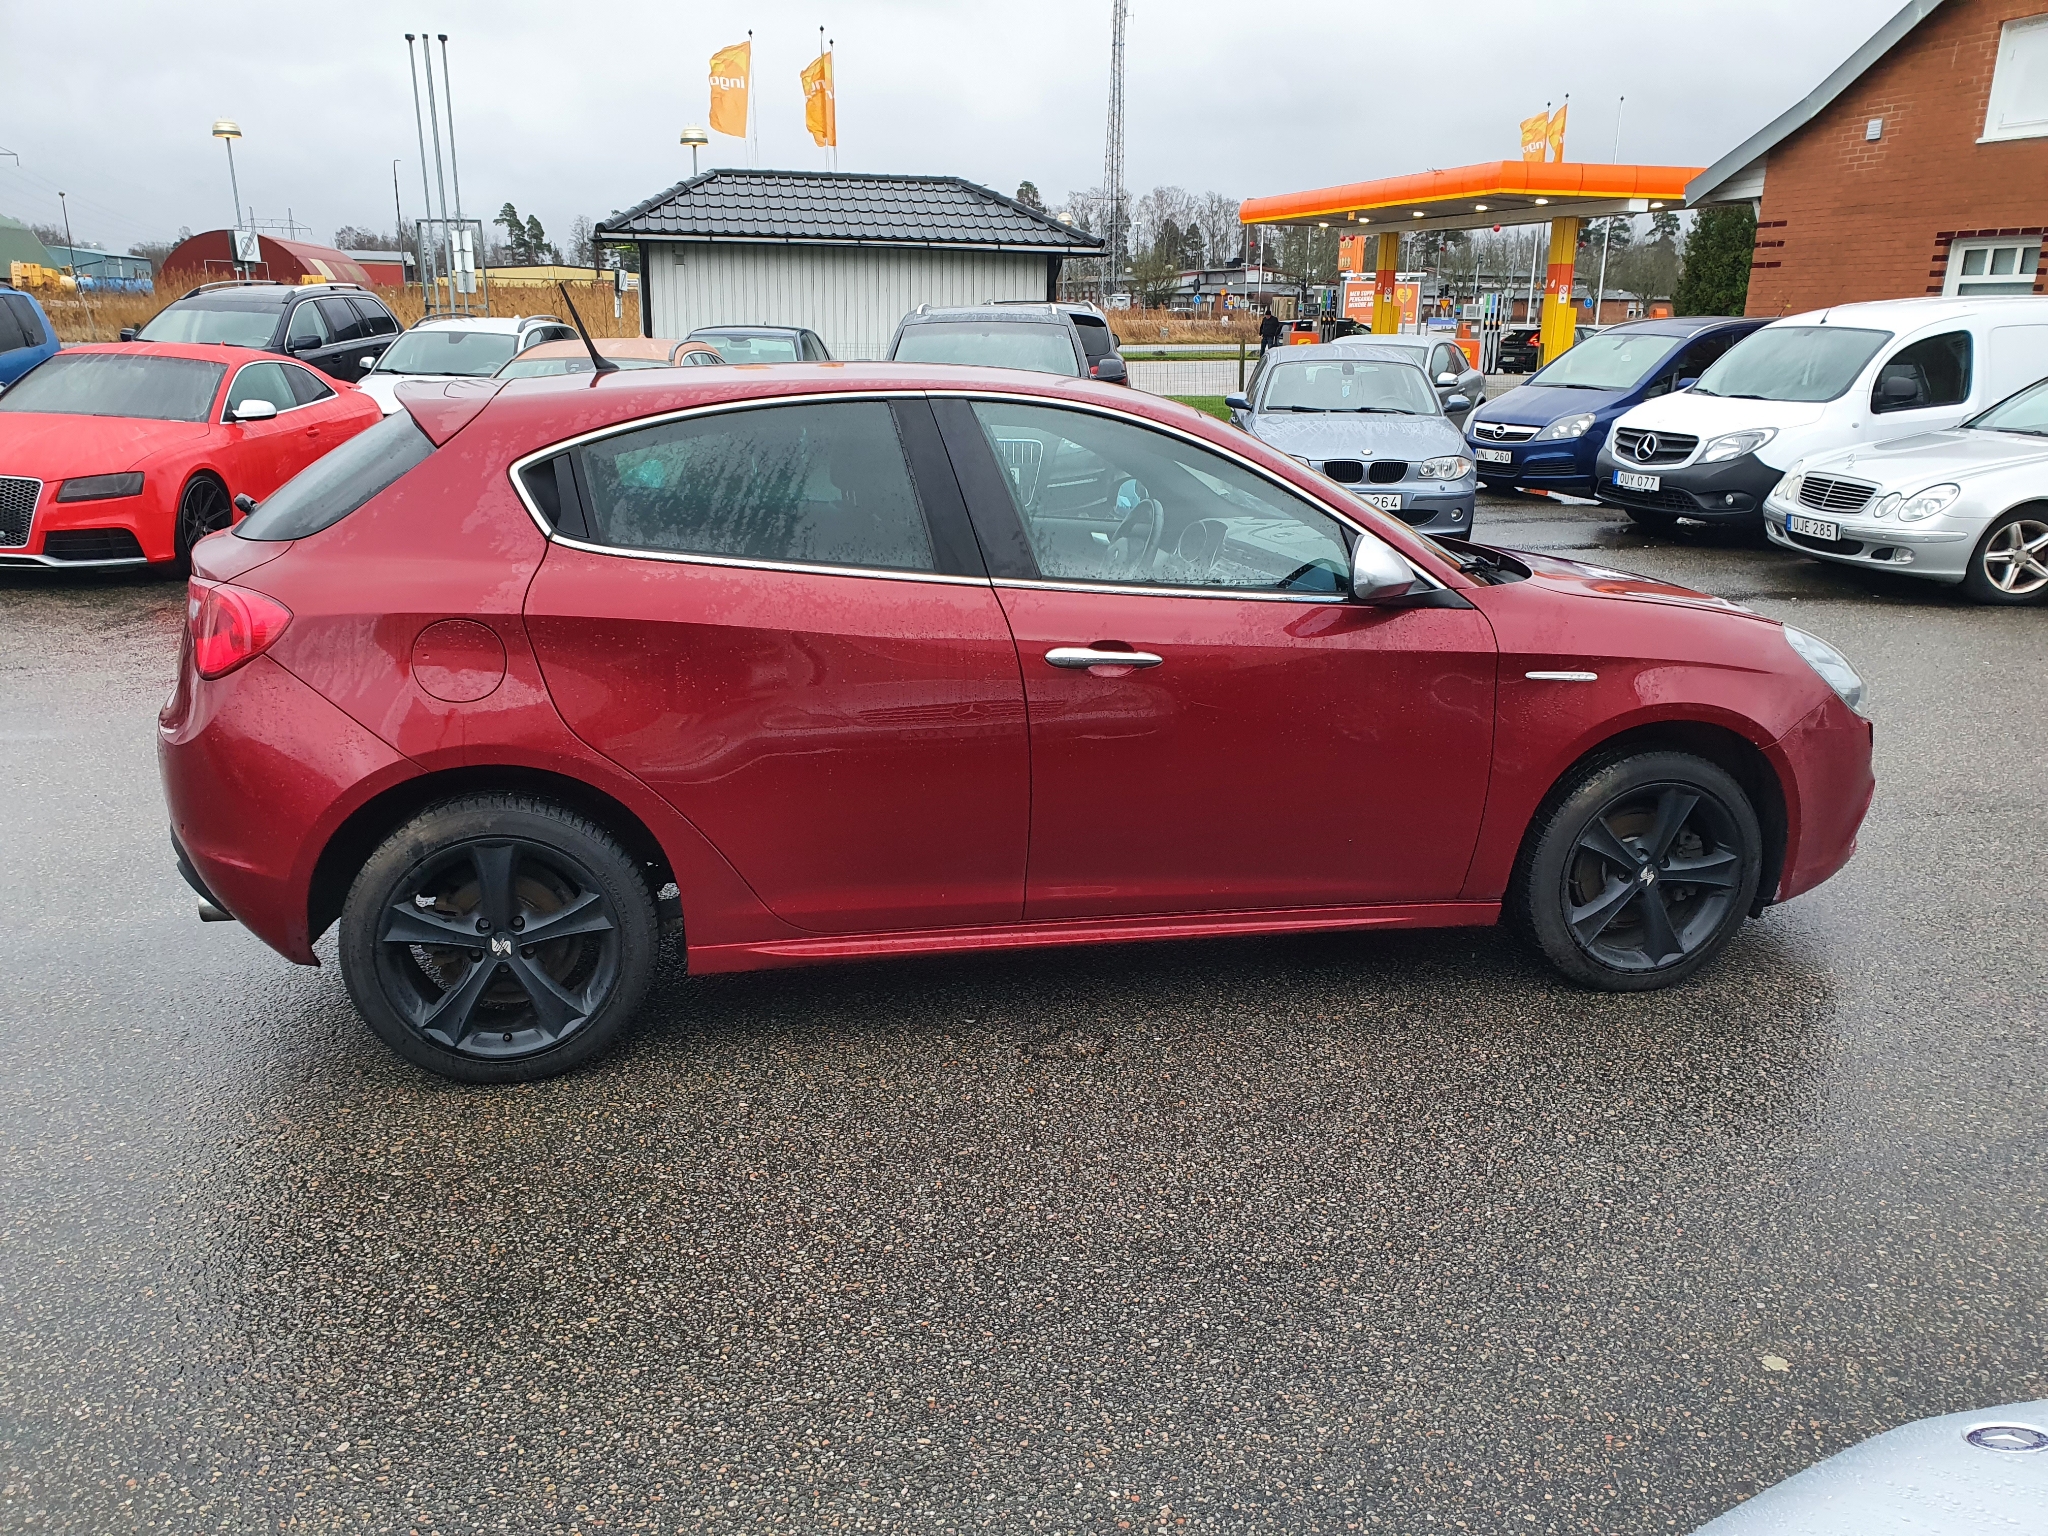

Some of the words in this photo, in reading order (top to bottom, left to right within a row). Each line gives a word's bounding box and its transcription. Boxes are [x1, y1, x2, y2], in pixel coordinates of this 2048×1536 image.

[1550, 279, 1556, 289] 4
[1476, 449, 1488, 460] NNL
[1494, 452, 1510, 462] 260
[1620, 473, 1635, 486] OUY
[1637, 476, 1656, 489] 077
[1372, 496, 1398, 508] 264
[1793, 517, 1810, 533] UJE
[1812, 522, 1832, 538] 285
